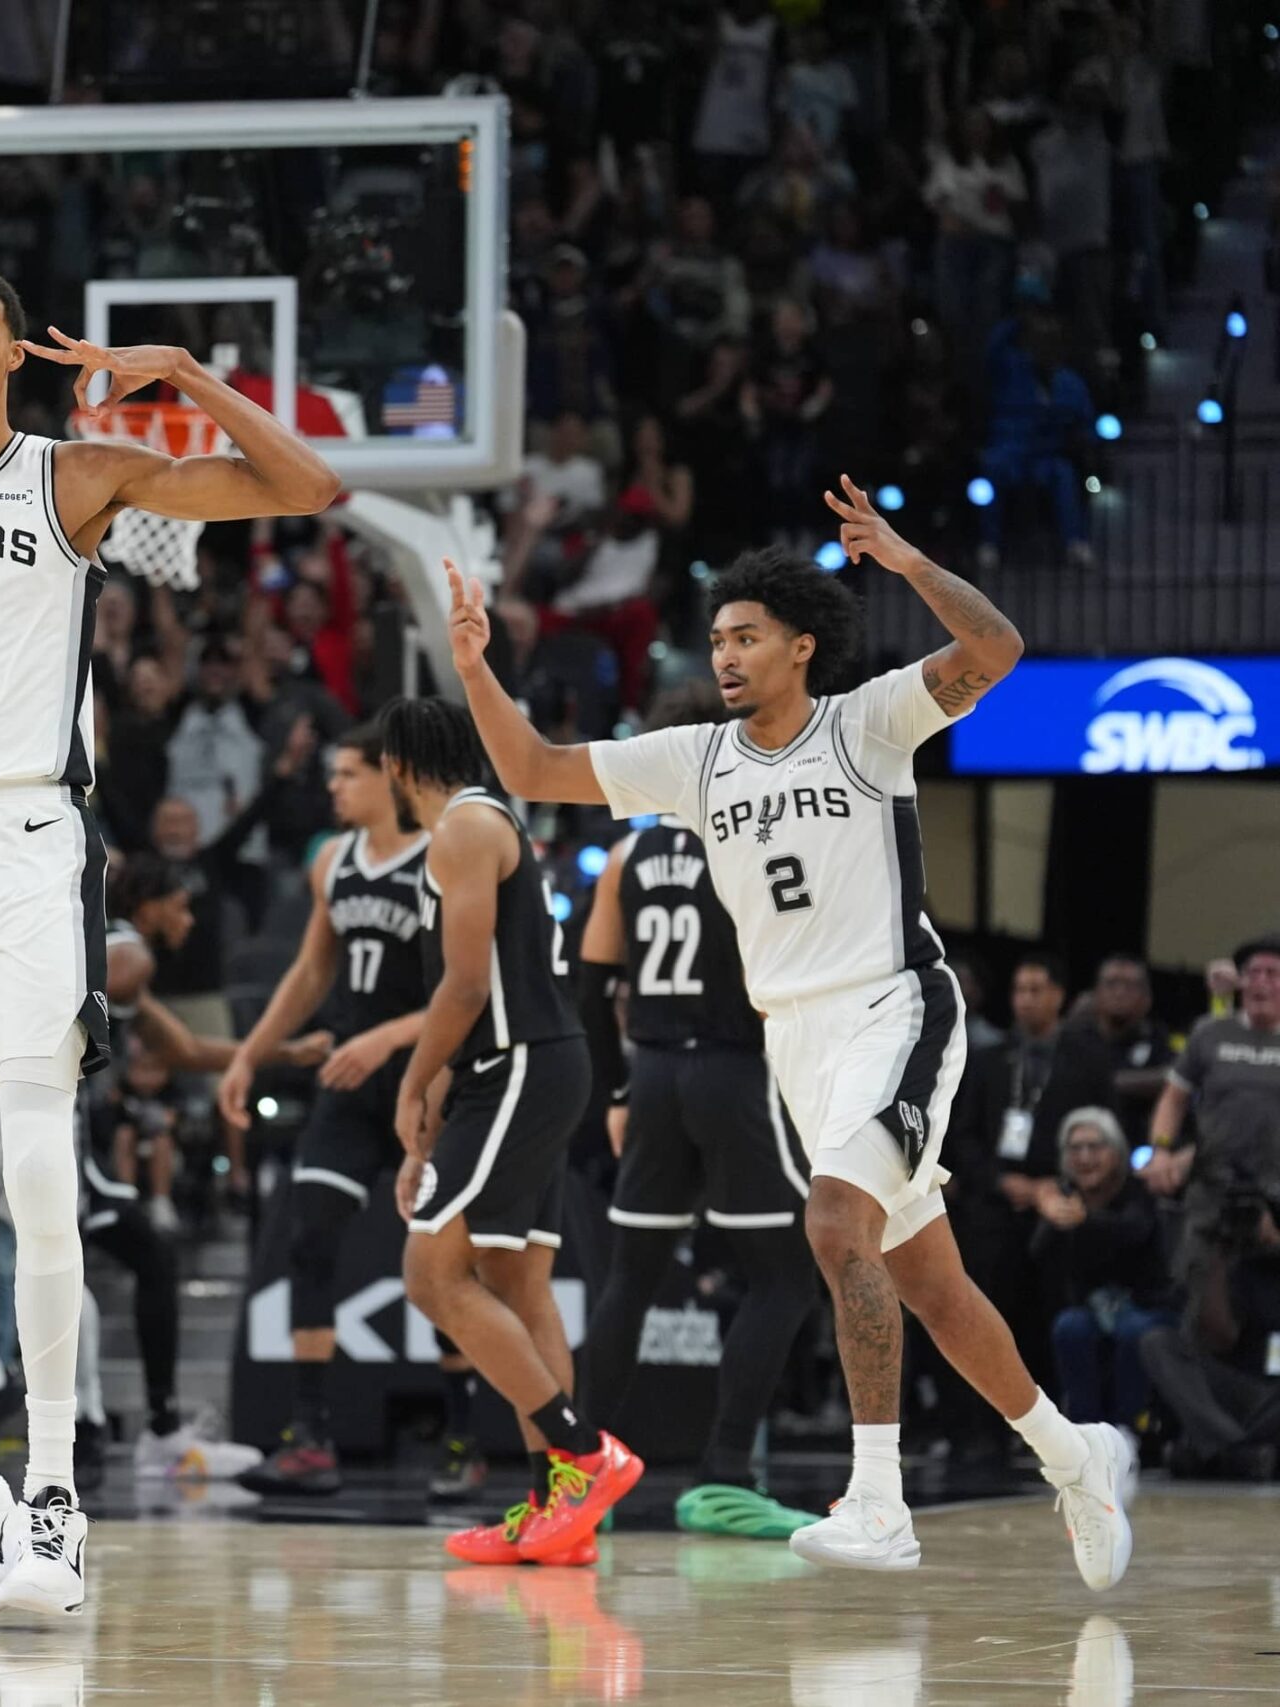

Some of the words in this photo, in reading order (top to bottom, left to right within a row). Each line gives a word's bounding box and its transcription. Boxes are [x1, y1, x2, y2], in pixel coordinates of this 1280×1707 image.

[1080, 710, 1265, 773] SWBC
[711, 788, 851, 845] SPURS
[763, 853, 814, 915] 2
[348, 937, 384, 993] 17
[636, 904, 703, 996] 22
